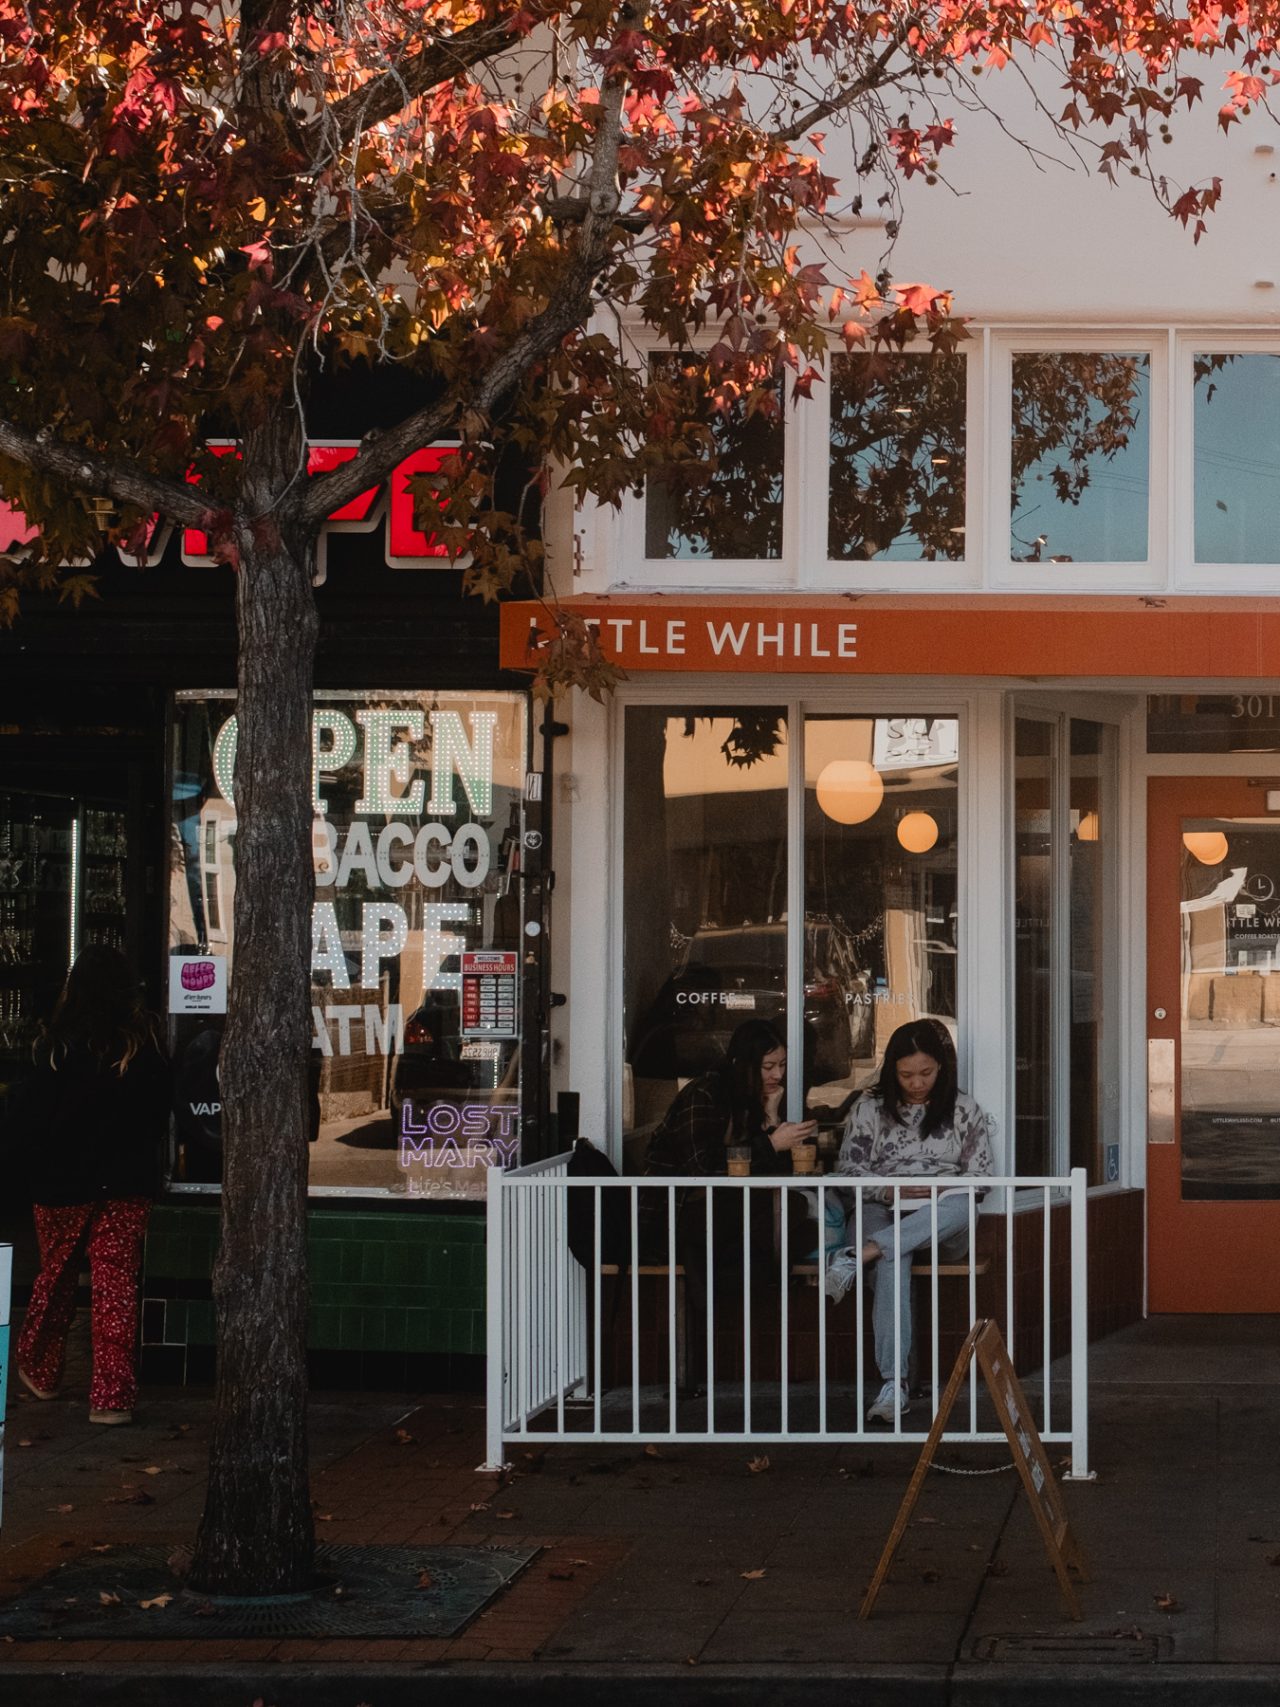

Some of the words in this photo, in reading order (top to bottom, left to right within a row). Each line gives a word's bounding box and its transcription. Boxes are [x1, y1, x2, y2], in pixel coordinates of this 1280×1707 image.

[529, 617, 687, 655] TLE
[705, 621, 858, 658] WHILE
[212, 709, 498, 816] PEN
[464, 963, 493, 972] BUSINESS
[493, 963, 515, 972] HOURS
[675, 991, 737, 1005] COFFEE
[844, 992, 915, 1005] PASTRIE
[401, 1103, 519, 1136] LOST
[401, 1136, 519, 1168] MARY
[409, 1176, 452, 1194] Life's
